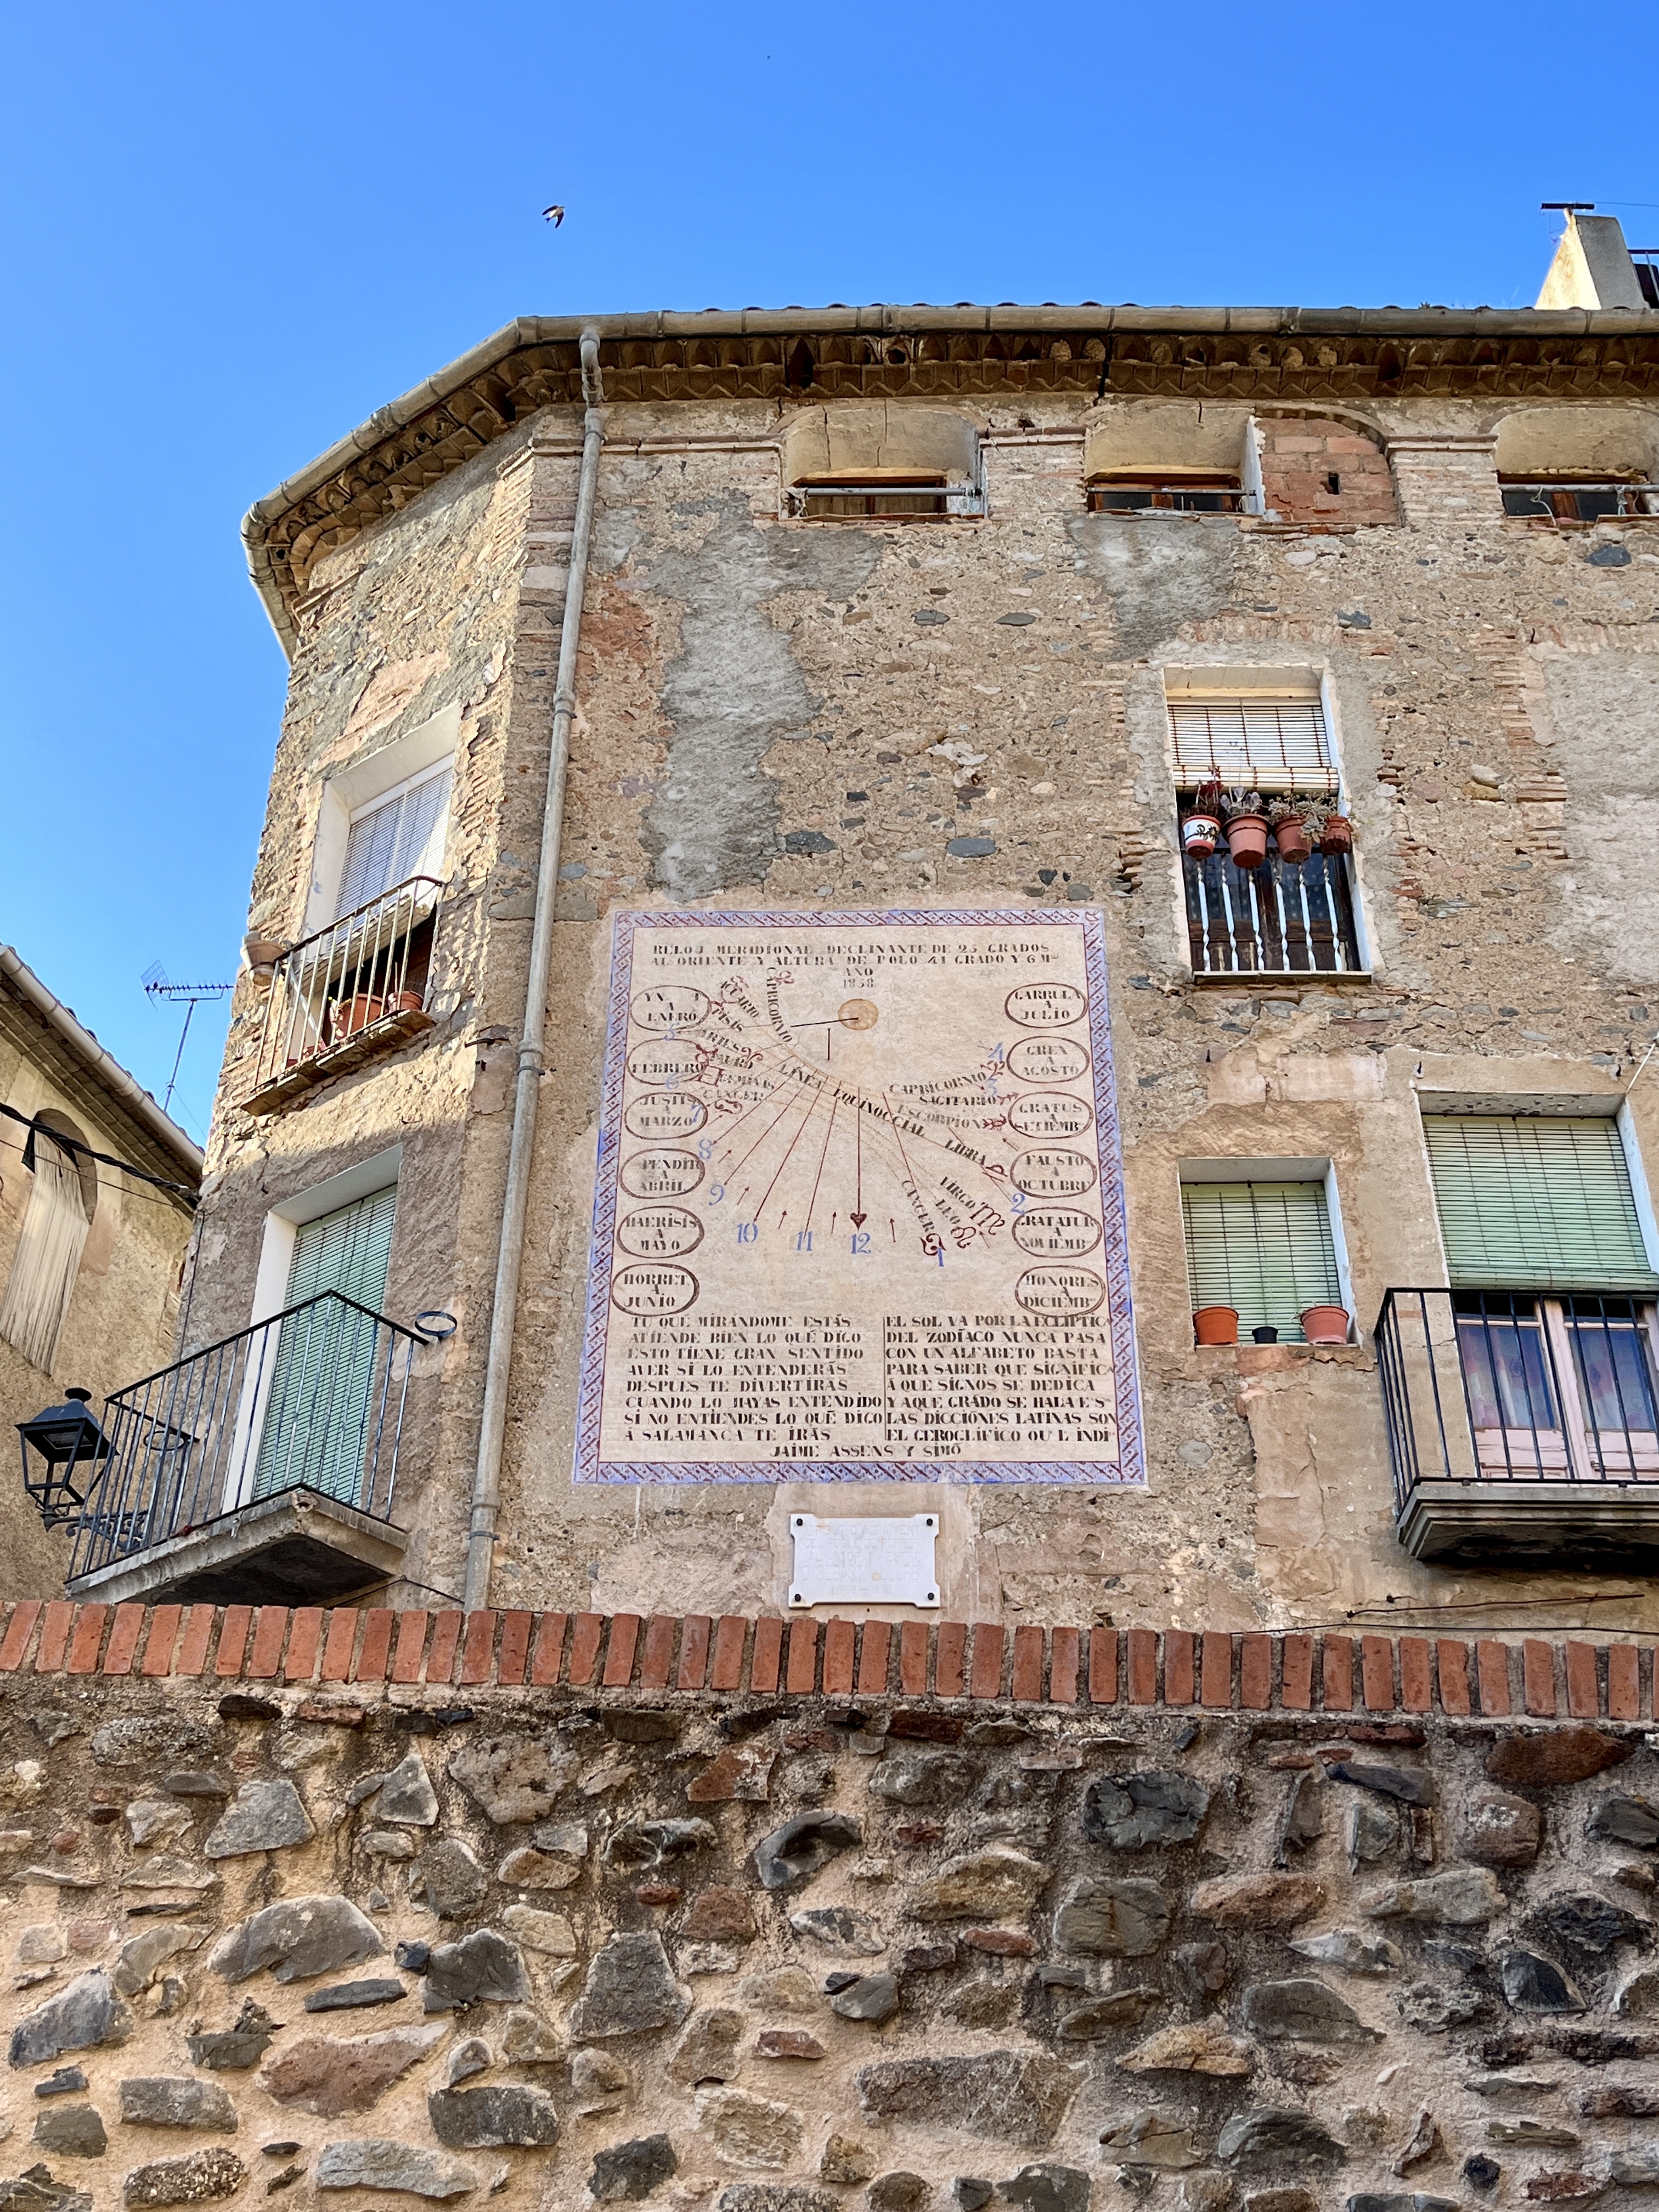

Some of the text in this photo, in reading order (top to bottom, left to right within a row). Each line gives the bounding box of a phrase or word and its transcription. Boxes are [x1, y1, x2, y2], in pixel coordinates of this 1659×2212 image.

[653, 945, 704, 955] RELOJ
[716, 945, 814, 955] MERIDIONAL
[827, 944, 928, 955] DECLINANTE
[932, 944, 951, 953] DE
[958, 944, 978, 953] 25
[651, 957, 670, 966] AL
[677, 956, 745, 966] ORIENTE
[756, 956, 766, 966] Y
[775, 956, 834, 966] ALTURA
[847, 955, 867, 965] DE
[877, 955, 918, 964] POLO
[1011, 955, 1022, 964] Y
[632, 1063, 703, 1074] FEBRERO
[640, 1116, 693, 1127] MARZO
[698, 1138, 713, 1160] 8
[944, 1139, 987, 1166] LIBRA
[708, 1184, 725, 1206] 9
[1010, 1193, 1026, 1215] 2
[736, 1223, 759, 1244] 10
[795, 1231, 813, 1251] 11
[851, 1232, 872, 1255] 12
[936, 1246, 944, 1267] 1
[623, 1274, 688, 1285] HORRET
[1025, 1274, 1099, 1286] HONORES
[887, 1315, 1031, 1327] EL SOL VA POR LA
[757, 1333, 777, 1344] LO
[887, 1331, 918, 1343] DEL
[1002, 1331, 1057, 1344] NUNCA
[1064, 1332, 1106, 1344] PASA
[628, 1348, 670, 1359] ESTO
[885, 1347, 1099, 1359] CON UN ALFABETO BASTA
[703, 1364, 723, 1376] LO
[887, 1363, 929, 1375] PARA
[934, 1363, 988, 1375] SABER
[995, 1363, 1028, 1377] QUE
[627, 1380, 700, 1392] DESPUES
[708, 1380, 729, 1392] TE
[900, 1380, 932, 1392] QUE
[1002, 1380, 1024, 1391] SE
[625, 1397, 692, 1408] CUANDO
[701, 1397, 722, 1408] LO
[733, 1397, 781, 1408] HAYAS
[887, 1397, 896, 1408] Y
[1007, 1397, 1027, 1408] SE
[648, 1413, 669, 1425] NO
[776, 1413, 797, 1425] LO
[887, 1412, 918, 1425] LAS
[1088, 1412, 1117, 1425] SON
[641, 1428, 743, 1442] SALAMANCA
[754, 1429, 777, 1441] TE
[887, 1429, 909, 1441] EL
[830, 1445, 894, 1458] ASSENS
[903, 1445, 915, 1457] Y
